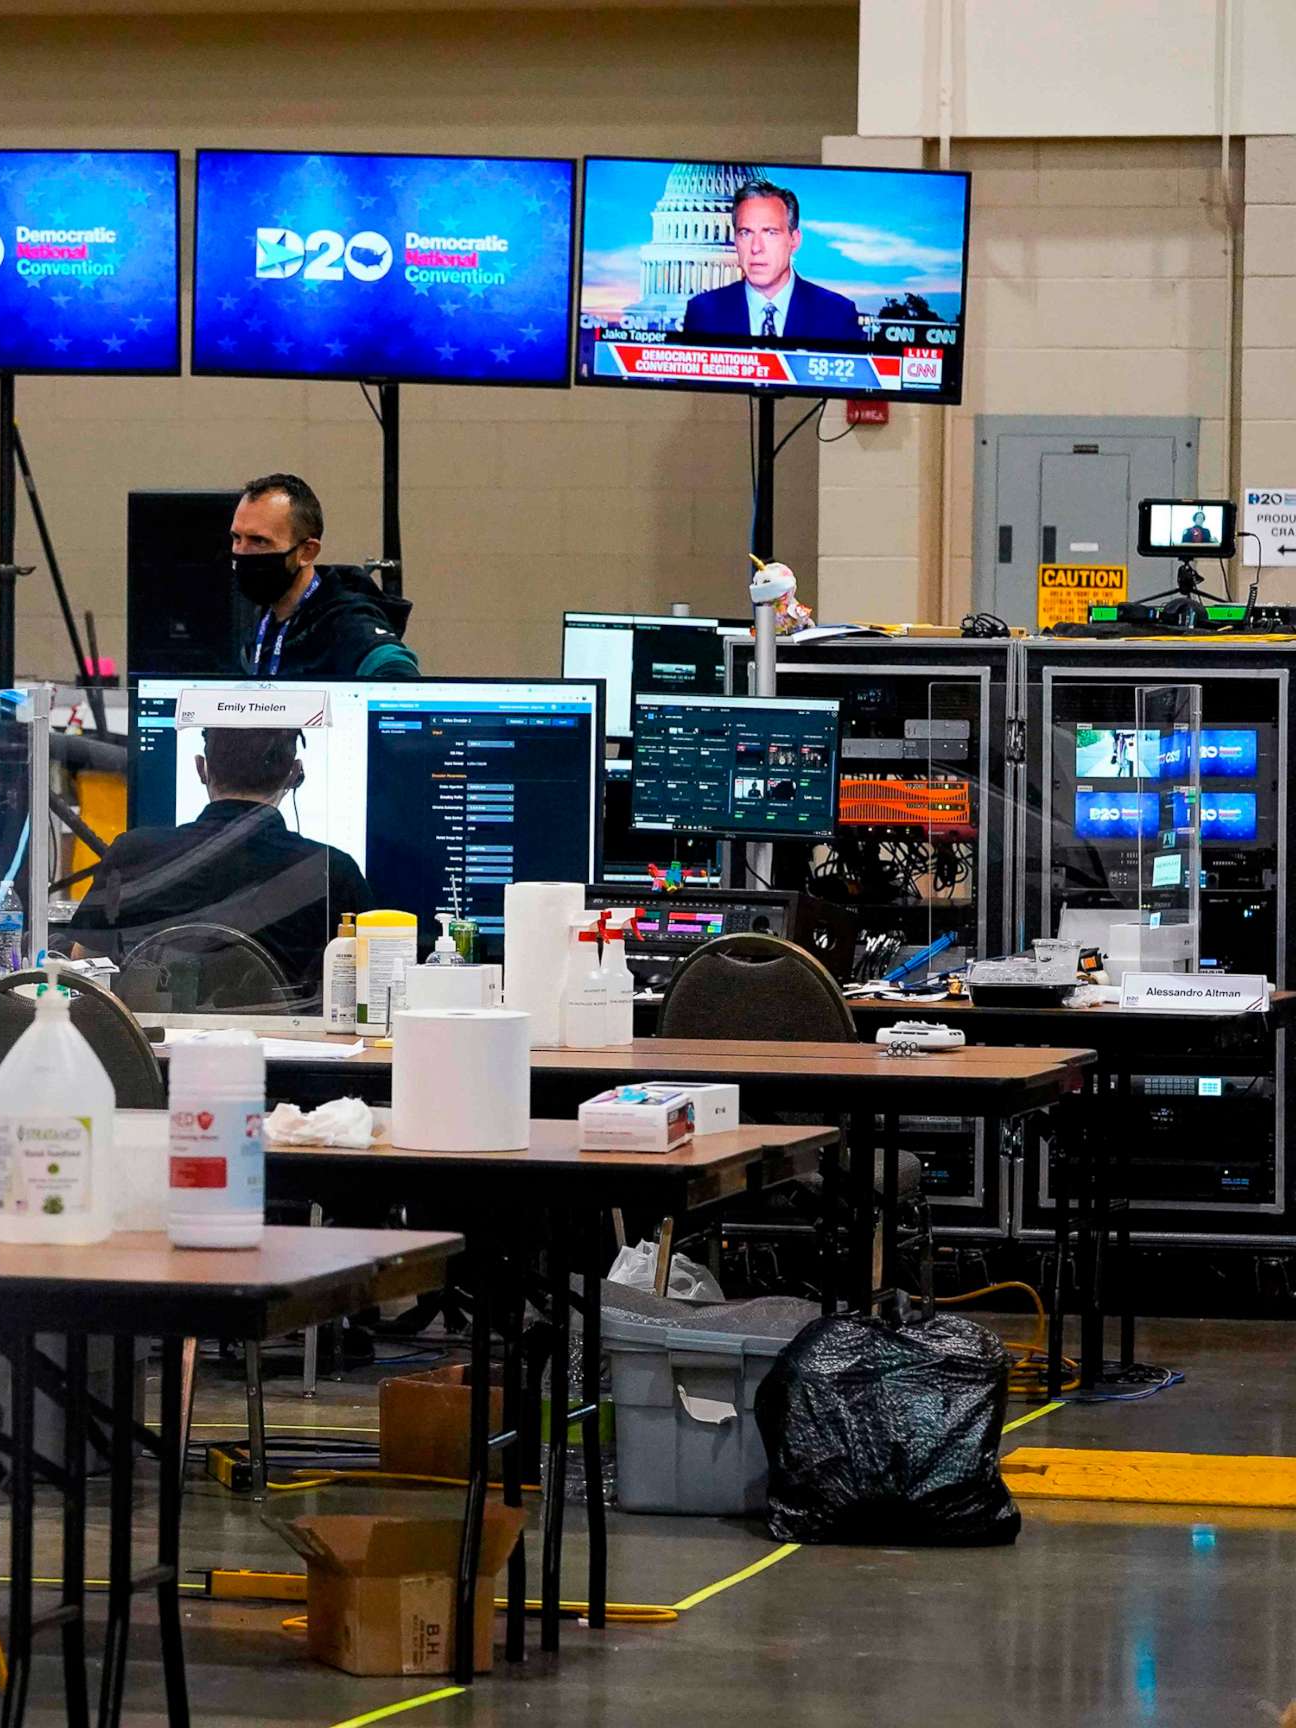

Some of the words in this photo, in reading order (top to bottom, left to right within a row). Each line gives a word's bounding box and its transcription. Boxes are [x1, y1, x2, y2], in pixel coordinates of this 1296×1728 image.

[16, 226, 117, 243] Democratic
[405, 232, 508, 252] Democratic
[16, 243, 88, 260] National
[255, 227, 394, 282] D20
[405, 251, 479, 268] National
[16, 260, 115, 276] Convention
[404, 265, 506, 285] Convention
[602, 329, 628, 341] Jake
[630, 330, 667, 343] Tapper
[885, 326, 916, 343] CNN
[926, 328, 957, 345] CNN
[642, 349, 708, 363] DEMOCRATIC
[710, 353, 761, 366] NATIONAL
[908, 348, 938, 358] LIVE
[635, 360, 702, 374] CONVENTION
[703, 363, 739, 376] BEGINS
[756, 366, 770, 378] ET
[808, 357, 855, 377] 58:22
[907, 361, 938, 378] CNN
[1248, 492, 1283, 505] D20
[1271, 527, 1296, 537] CRA
[1043, 569, 1122, 588] CAUTION
[217, 702, 247, 714] Emily
[248, 702, 287, 712] Thielen
[1146, 987, 1204, 998] Alessandro
[1205, 988, 1242, 998] Altman
